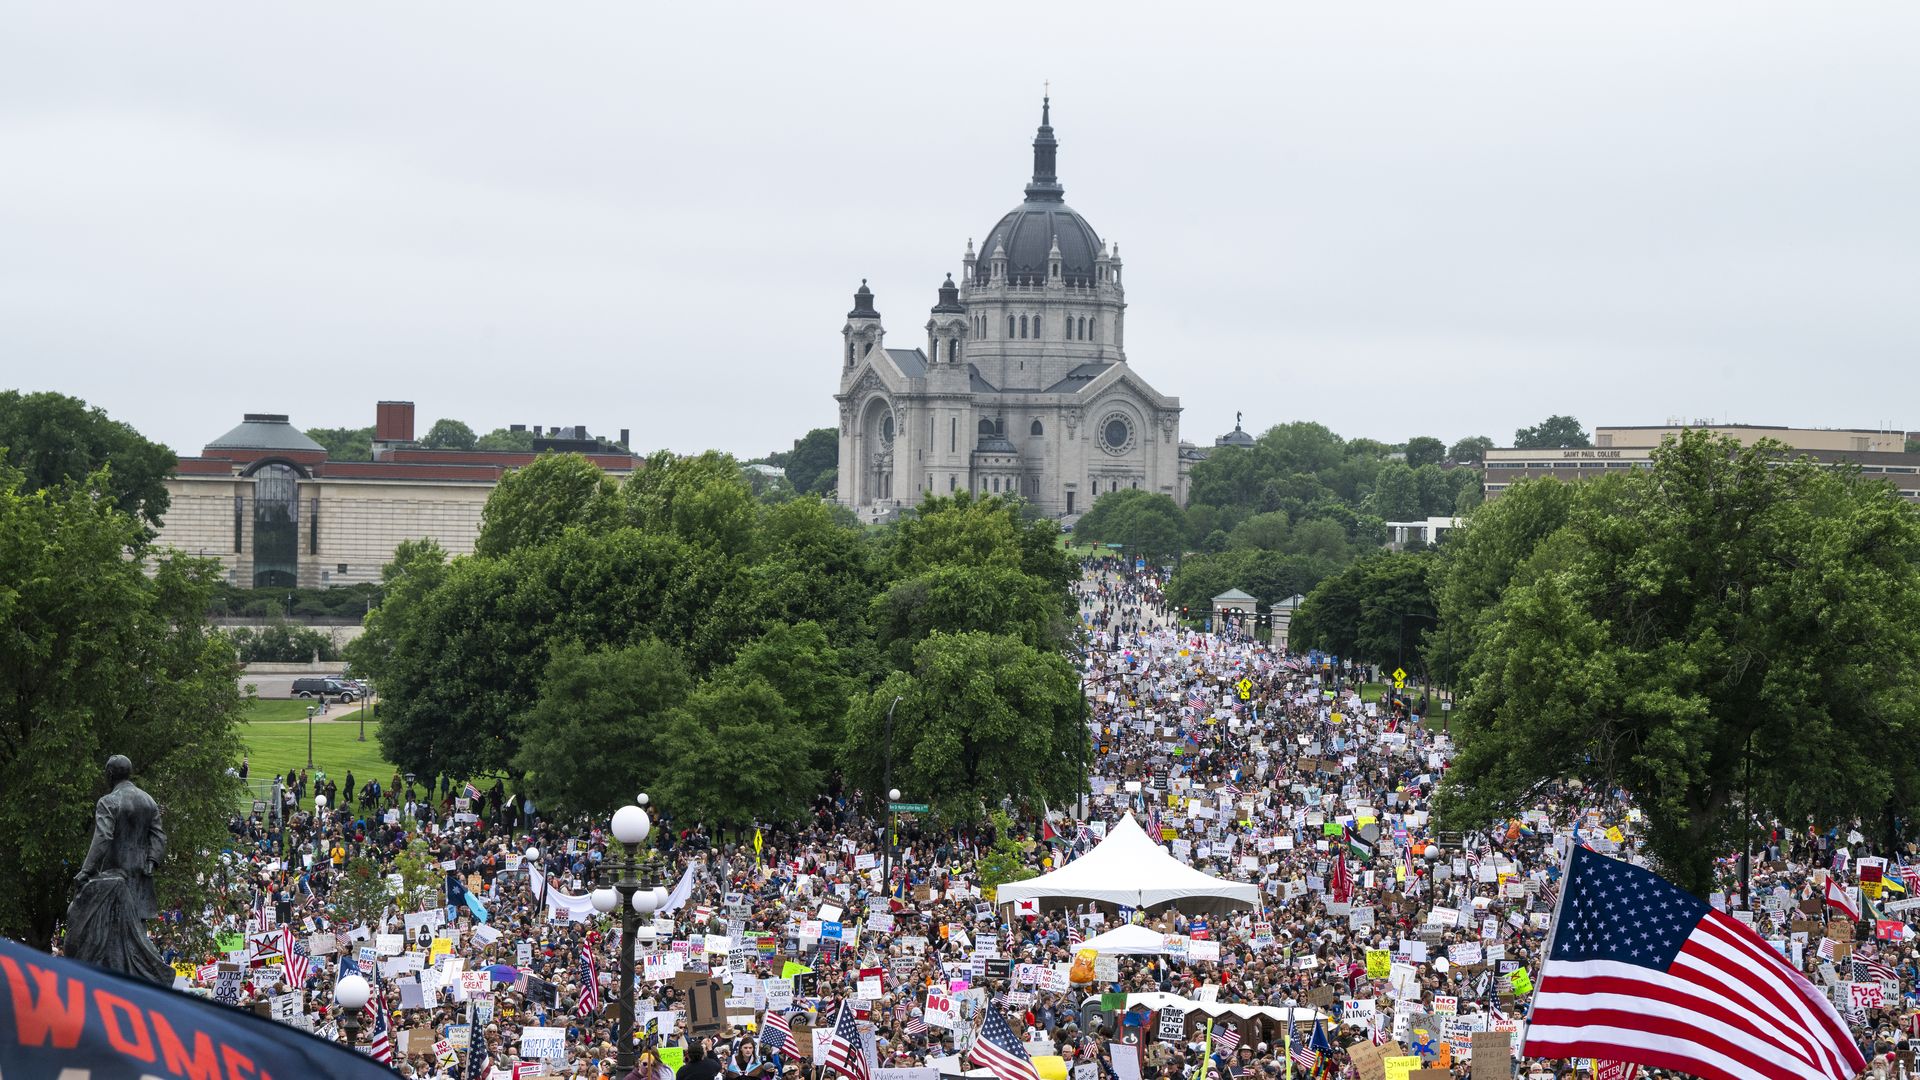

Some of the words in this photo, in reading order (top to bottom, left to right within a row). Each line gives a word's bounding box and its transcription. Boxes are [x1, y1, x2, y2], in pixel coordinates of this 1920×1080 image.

[824, 922, 840, 931] Save
[647, 954, 667, 966] HATE
[462, 973, 474, 981] ARE
[216, 986, 237, 998] OUR
[470, 992, 493, 1001] LOVE
[1852, 985, 1884, 1000] FUCK
[928, 995, 949, 1012] NO
[1855, 998, 1884, 1008] ICE
[0, 954, 273, 1080] WOME
[1346, 1010, 1371, 1018] KINGS
[436, 1041, 448, 1050] NO
[524, 1039, 546, 1050] PROFIT
[548, 1038, 564, 1049] OVER
[435, 1046, 452, 1057] KINGS
[541, 1048, 548, 1057] IS
[550, 1048, 564, 1058] EVIL
[1386, 1058, 1410, 1069] STAND
[1410, 1056, 1420, 1066] UP
